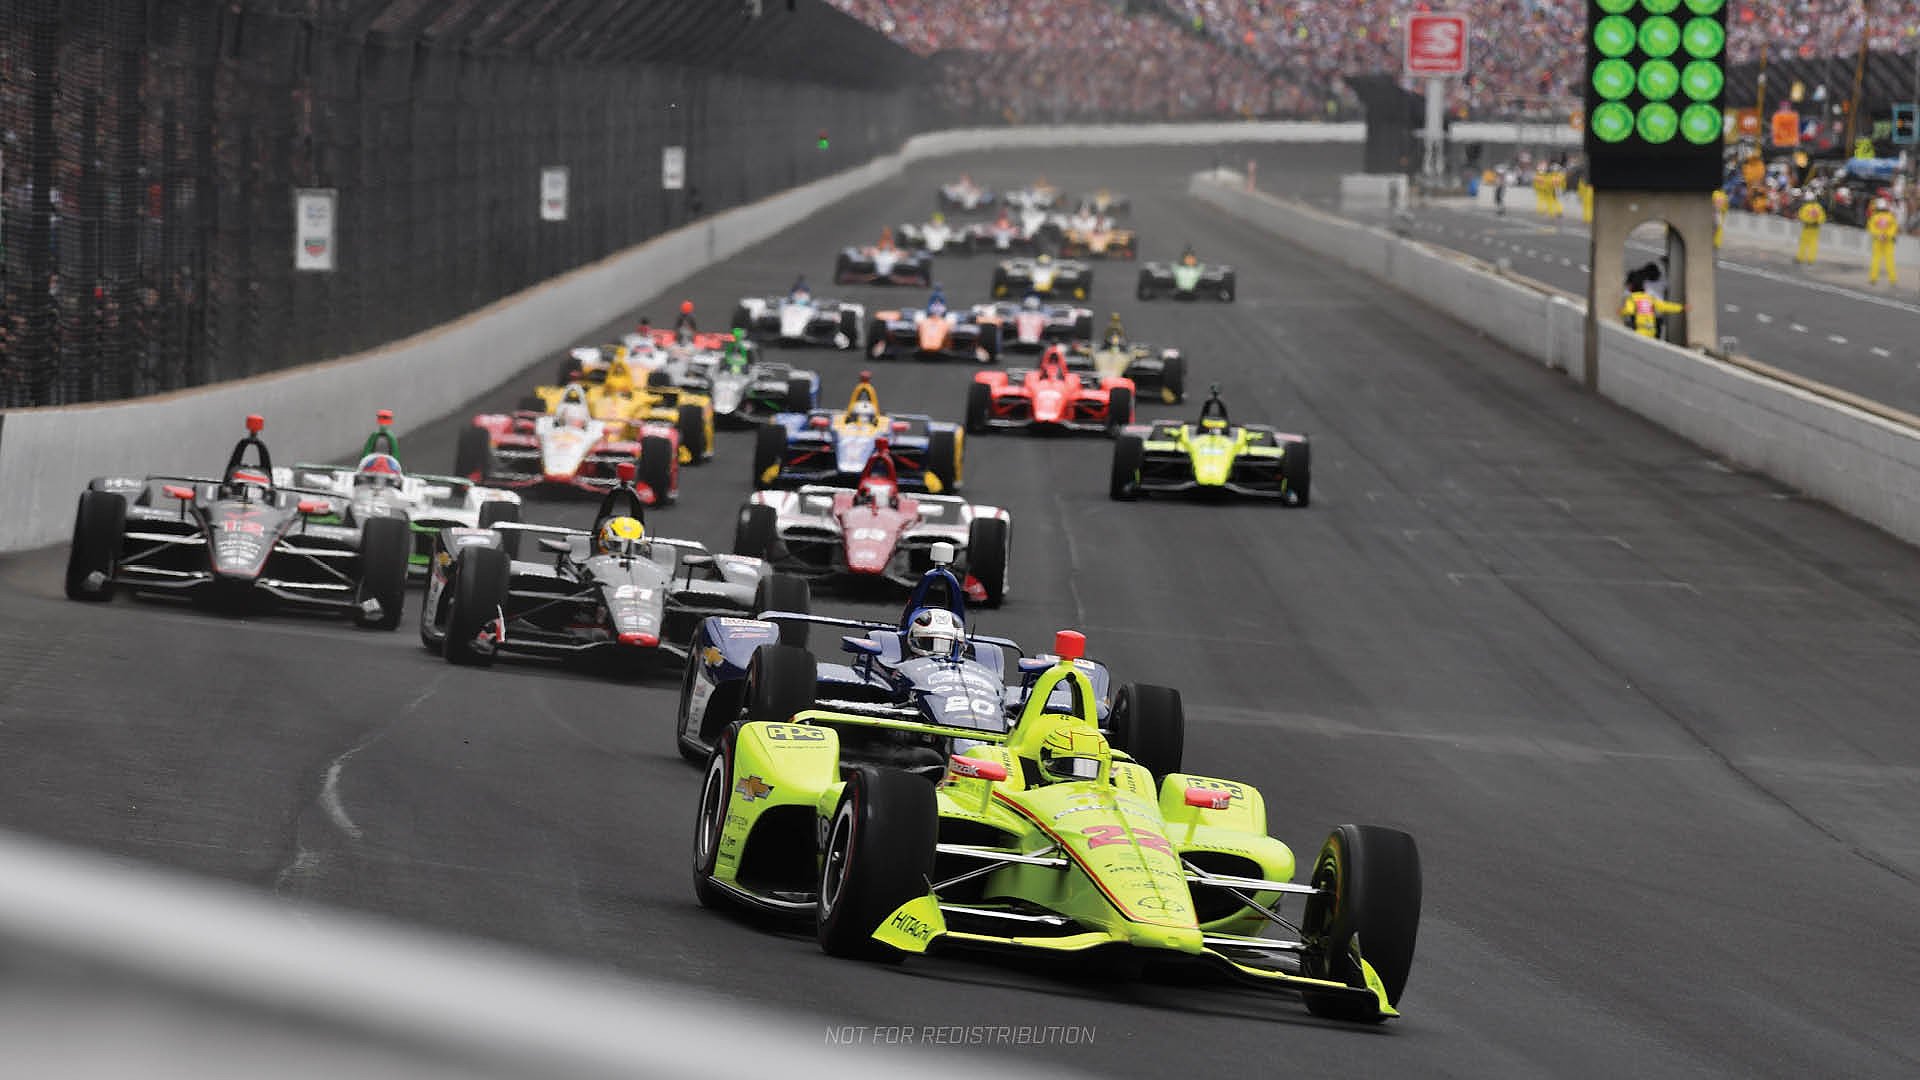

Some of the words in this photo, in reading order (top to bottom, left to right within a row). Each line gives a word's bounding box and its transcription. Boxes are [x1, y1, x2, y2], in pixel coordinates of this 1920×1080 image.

[945, 695, 996, 715] 20
[766, 724, 825, 741] PPG
[1081, 825, 1177, 857] 22
